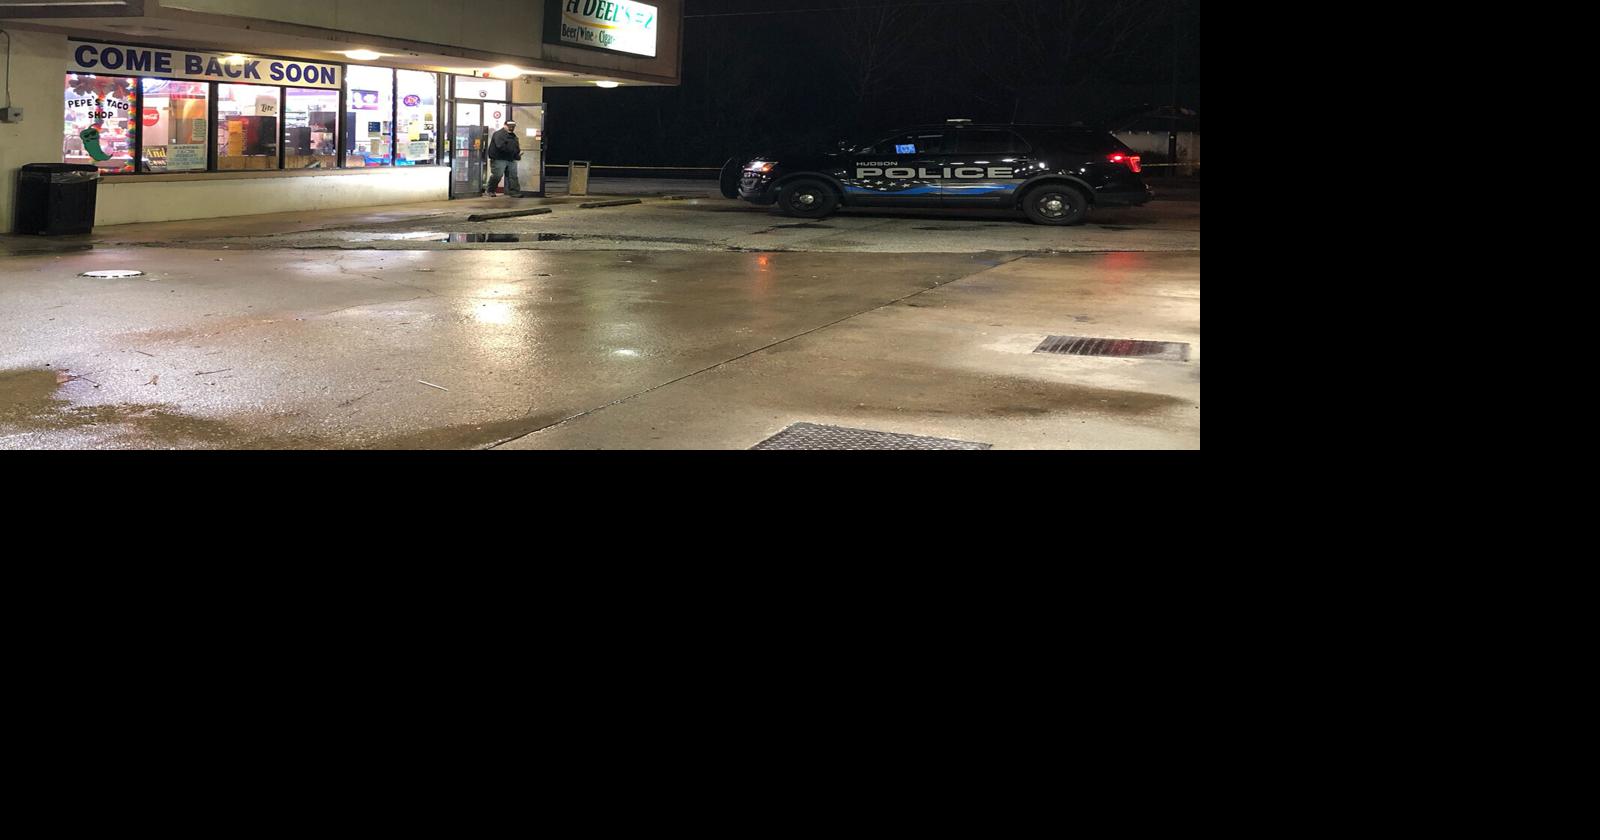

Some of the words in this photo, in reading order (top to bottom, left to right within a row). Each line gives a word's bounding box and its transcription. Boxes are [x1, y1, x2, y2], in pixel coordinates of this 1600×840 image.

[74, 45, 172, 74] COME
[185, 54, 261, 80] BACK
[269, 62, 336, 85] SOON
[68, 96, 101, 108] PEPE'S
[107, 99, 129, 110] TACO
[261, 103, 274, 113] Lite
[88, 111, 114, 119] SHOP
[856, 167, 1014, 179] POLICE
